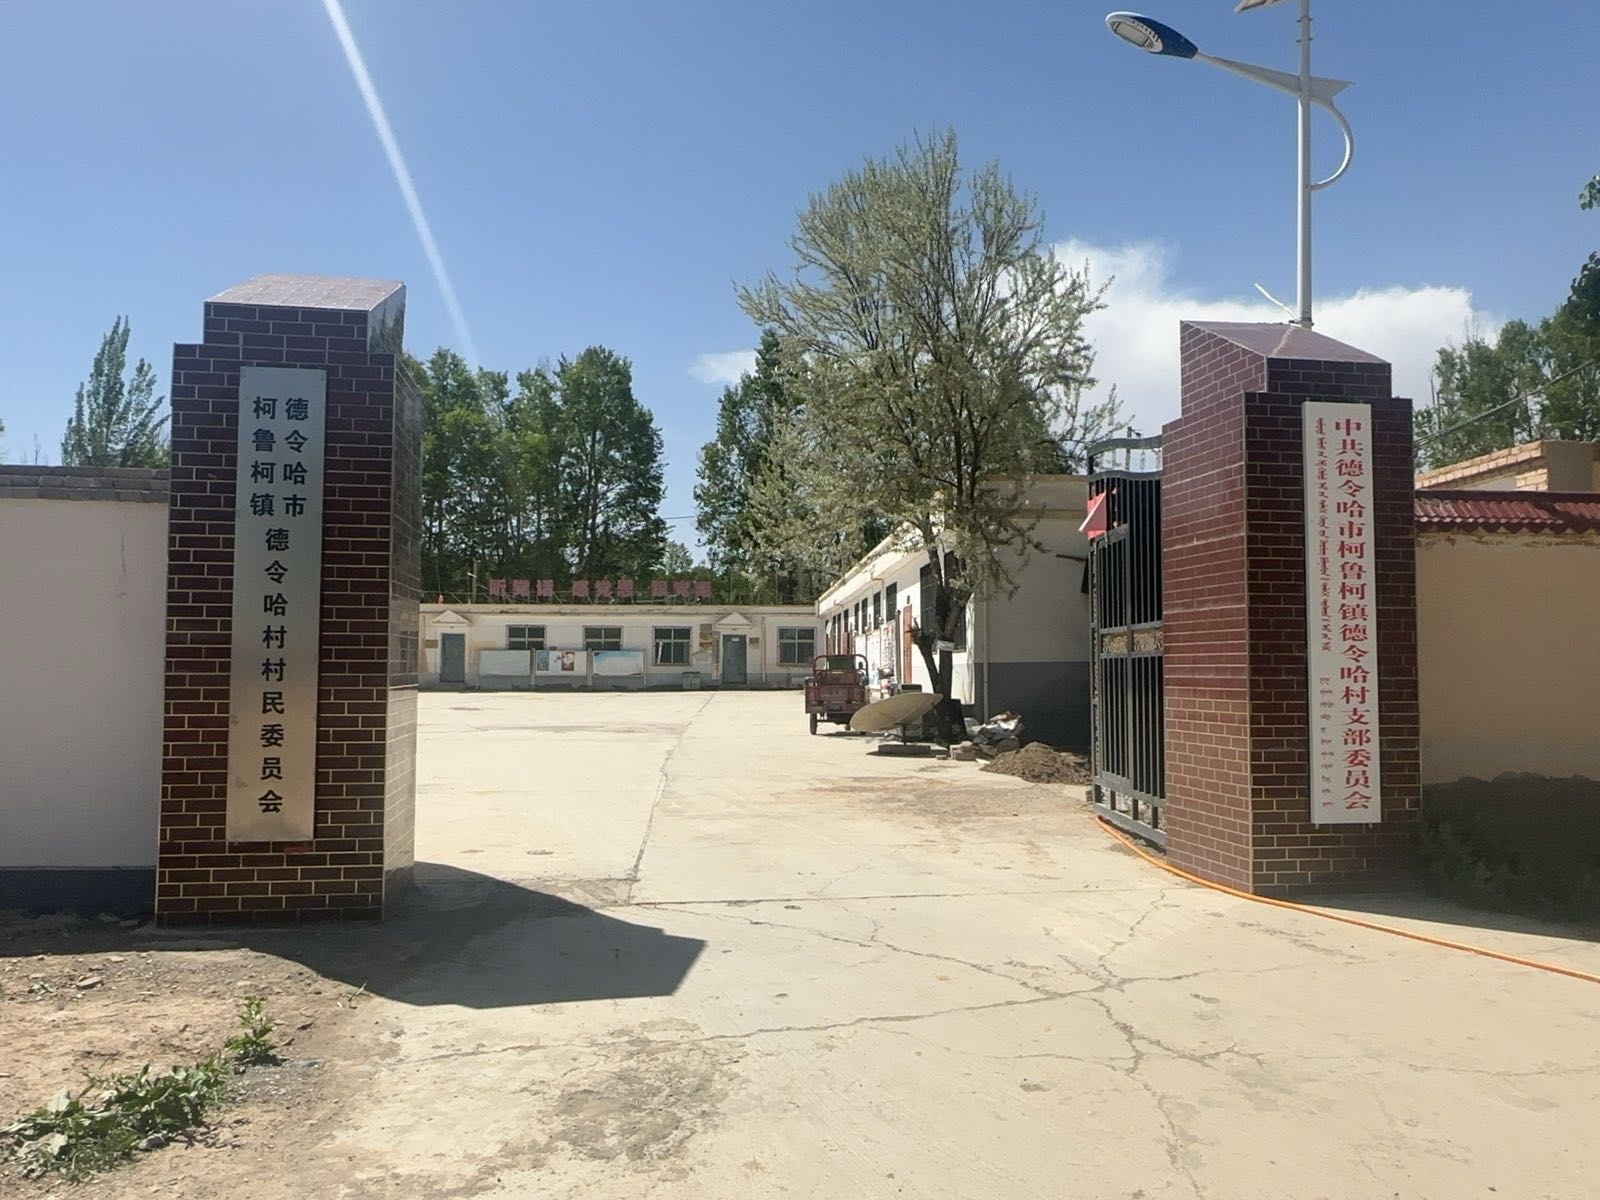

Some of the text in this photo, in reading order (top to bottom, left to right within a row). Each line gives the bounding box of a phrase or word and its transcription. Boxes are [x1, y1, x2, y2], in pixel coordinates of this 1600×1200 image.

[249, 396, 278, 517] 柯鲁柯镇
[282, 396, 309, 517] 德令哈市
[258, 528, 290, 813] 德令哈村村民委员会
[1335, 418, 1372, 810] 中共德令哈市柯鲁柯镇德令哈村支部委员会
